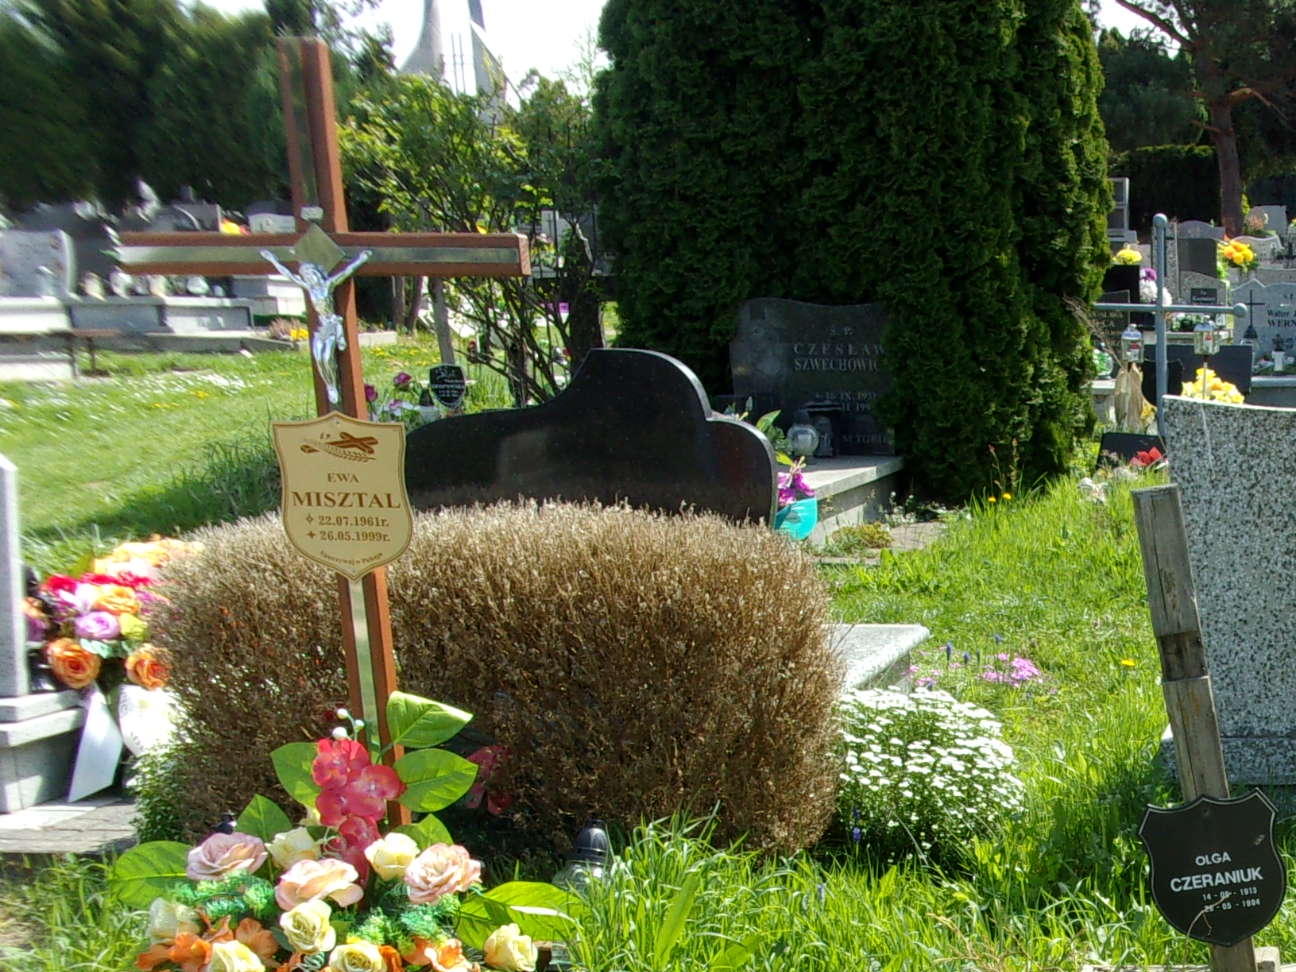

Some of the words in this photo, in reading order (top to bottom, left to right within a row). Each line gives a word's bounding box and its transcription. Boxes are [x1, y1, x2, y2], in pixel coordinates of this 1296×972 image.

[327, 472, 360, 483] EWA
[291, 491, 401, 509] MISZTAL
[1195, 851, 1232, 866] OLGA
[1170, 866, 1264, 892] CZERANIUK
